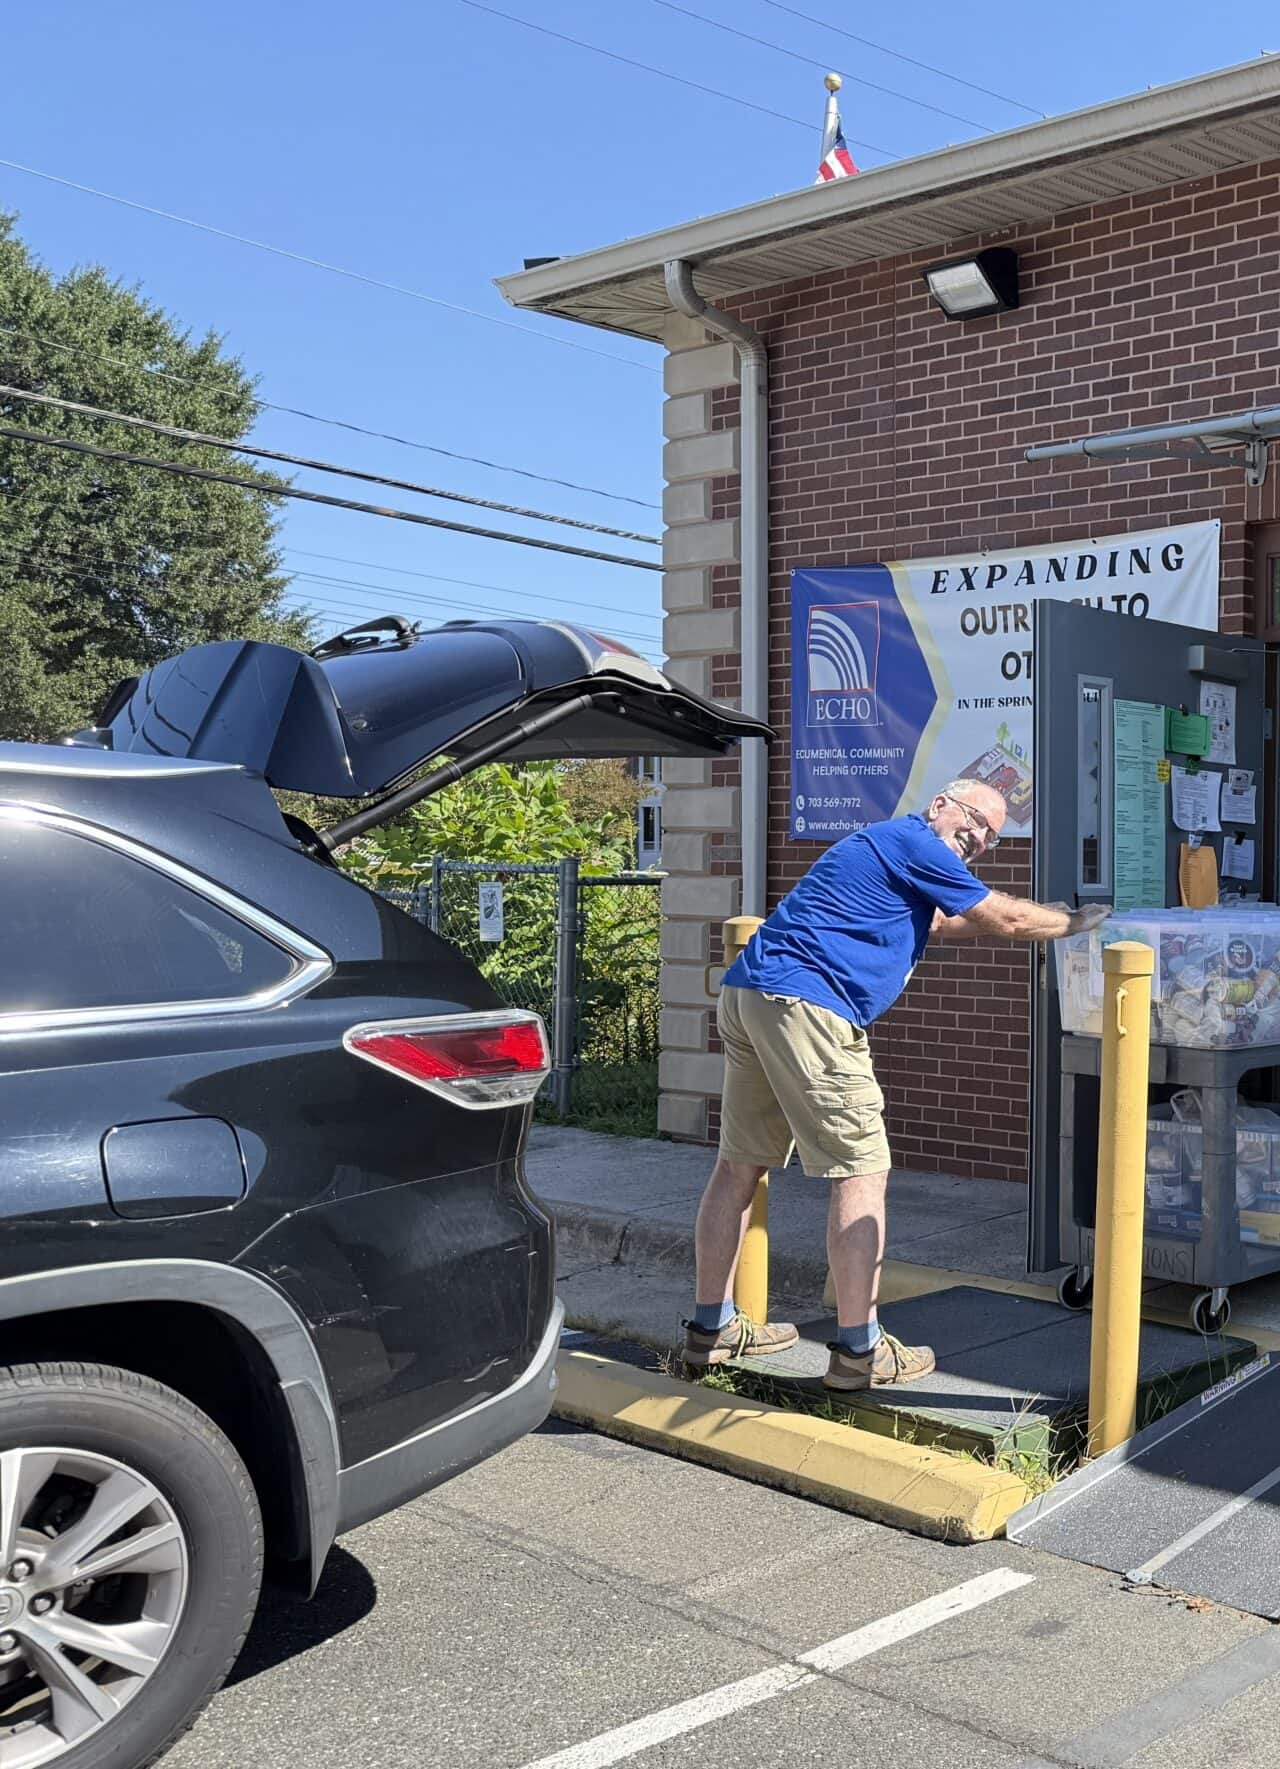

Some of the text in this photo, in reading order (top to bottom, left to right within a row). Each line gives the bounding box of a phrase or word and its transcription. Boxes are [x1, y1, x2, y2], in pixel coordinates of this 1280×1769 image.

[930, 543, 1184, 594] EXPANDING
[1111, 592, 1149, 617] TO
[815, 697, 871, 721] ECHO
[958, 695, 1033, 710] IN THE SPRIN
[795, 747, 905, 760] ECUMENICAL COMMUNITY
[812, 765, 889, 776] HELPING OTHERS
[808, 797, 861, 808] 703 569-7972
[1203, 1375, 1237, 1401] WARNING
